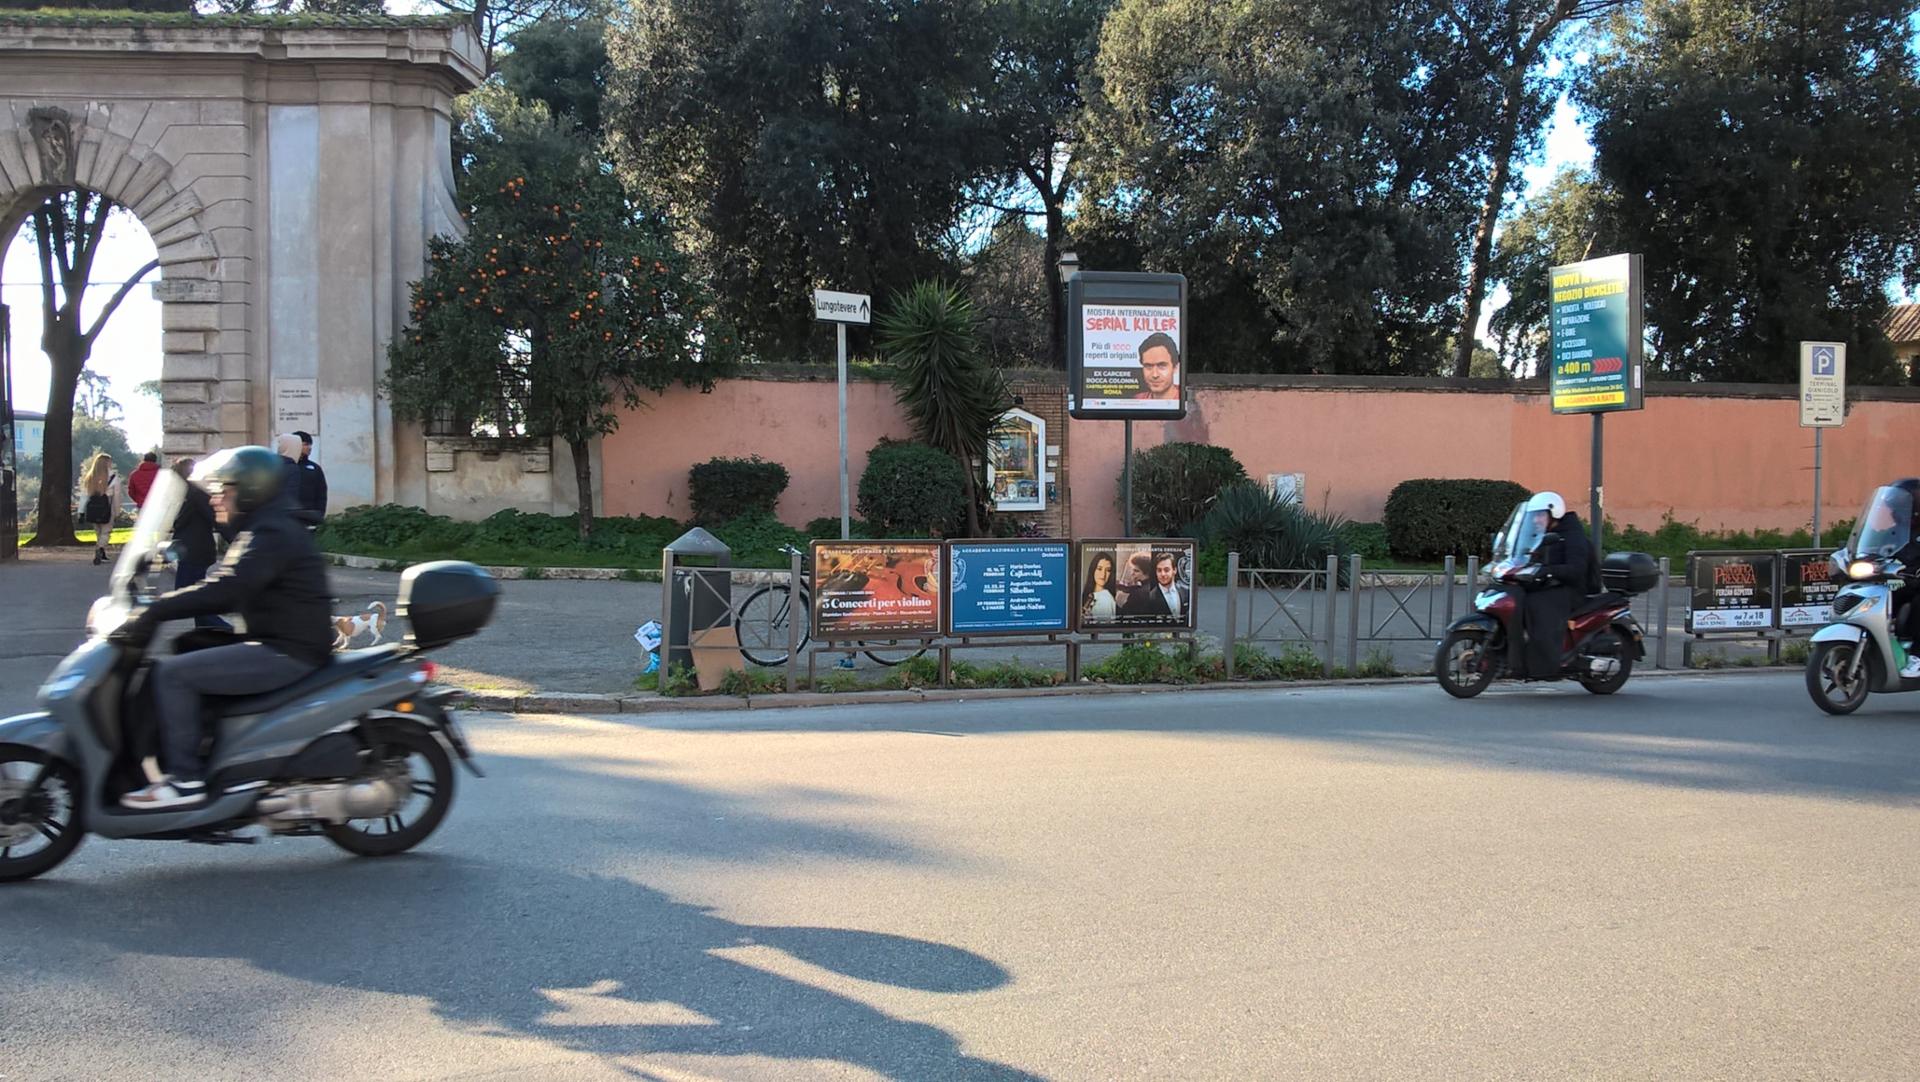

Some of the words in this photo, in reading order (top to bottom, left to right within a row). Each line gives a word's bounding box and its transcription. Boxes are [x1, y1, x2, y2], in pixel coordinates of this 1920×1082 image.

[1554, 288, 1583, 304] NEGOZIO
[1584, 281, 1625, 298] BICICLETTE
[817, 298, 857, 313] Lungotevere
[1087, 308, 1116, 316] MOSTRA
[1117, 309, 1175, 317] INTERNAZIONALE
[1086, 317, 1130, 331] SERIAL
[1133, 318, 1177, 331] KILLER
[1104, 342, 1111, 350] di
[1085, 352, 1108, 360] reperti
[1110, 352, 1137, 360] originali
[1557, 366, 1564, 375] a
[1564, 361, 1580, 374] 400
[1581, 362, 1591, 372] m
[1818, 355, 1830, 373] P
[1714, 566, 1757, 585] PRESENZA
[1801, 564, 1830, 582] PRESE
[831, 598, 876, 609] Concerti
[877, 600, 896, 610] per
[897, 596, 932, 607] violino
[1743, 611, 1748, 619] 7
[1755, 611, 1764, 619] 18
